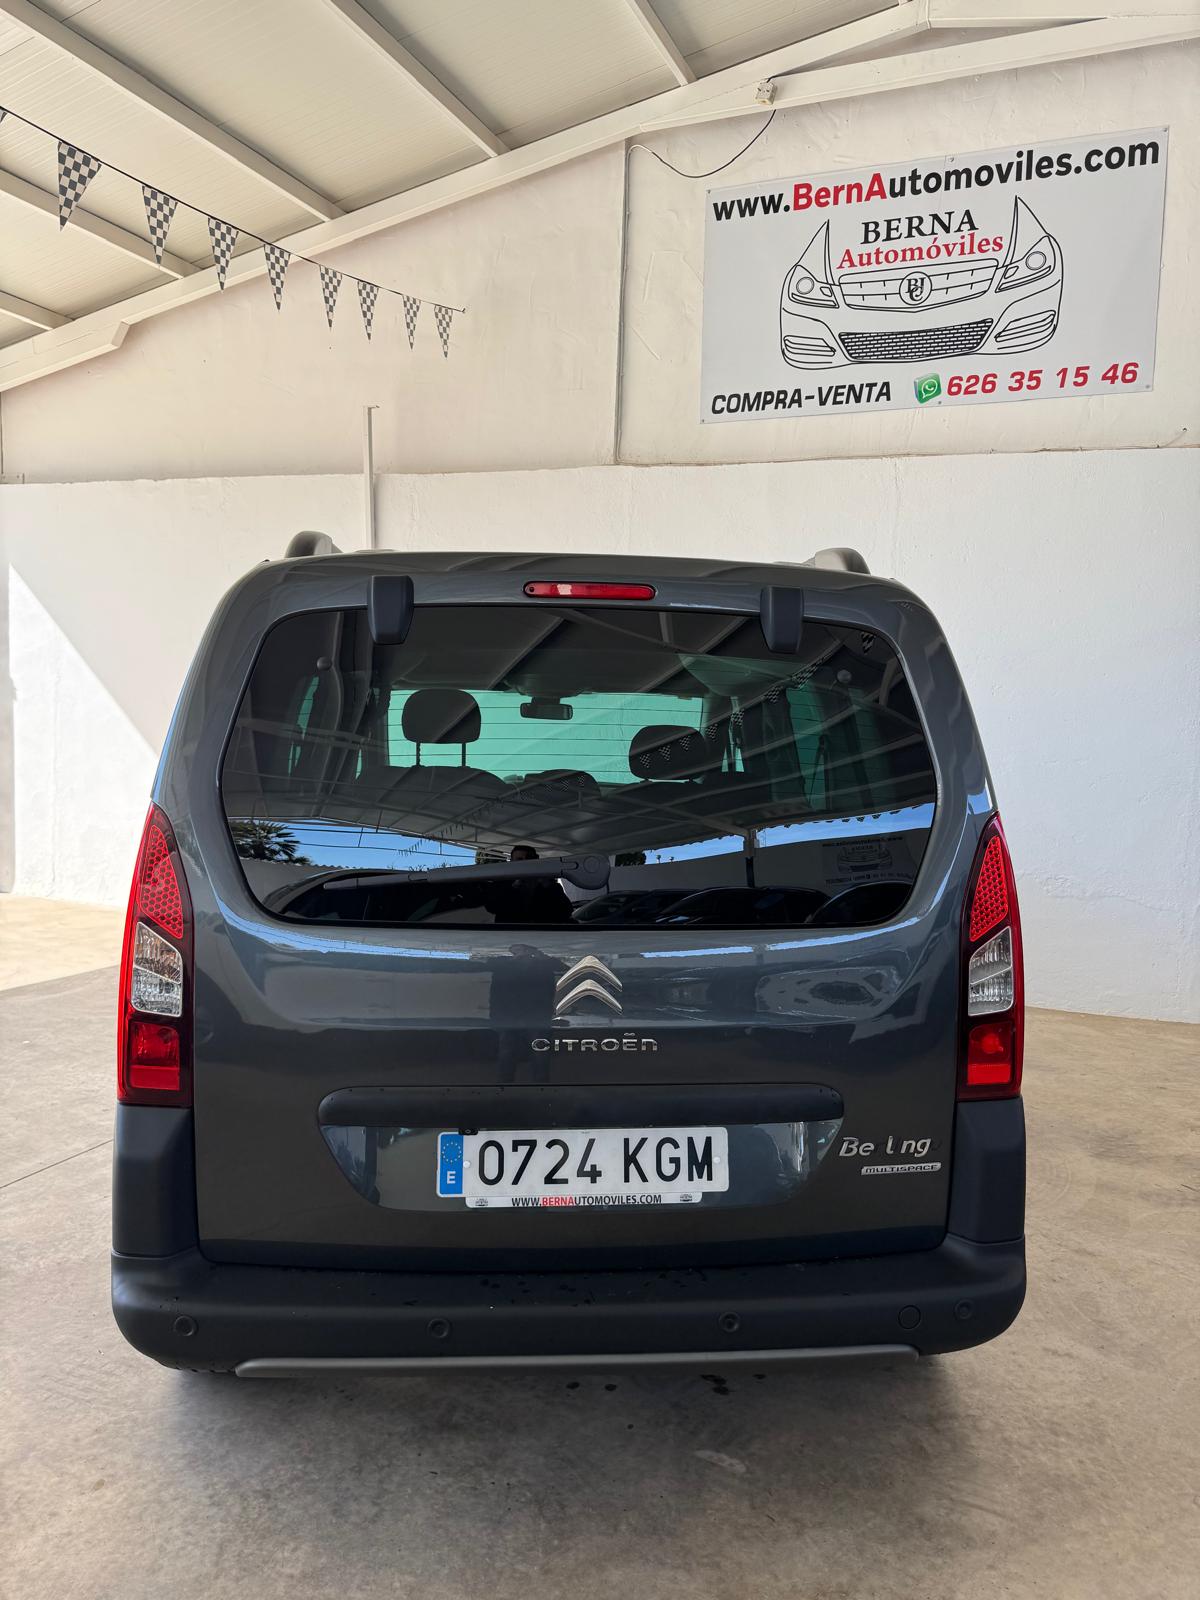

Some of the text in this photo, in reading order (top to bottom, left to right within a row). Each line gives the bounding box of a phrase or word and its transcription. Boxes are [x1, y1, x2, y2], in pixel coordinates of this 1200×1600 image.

[713, 141, 1160, 221] www.BernAutomoviles.com
[860, 209, 979, 245] BERNA
[838, 232, 1004, 269] Automóviles
[947, 361, 1139, 397] 626 35 15 46
[711, 381, 892, 415] COMPRA-VENTA
[446, 1136, 713, 1186] E 0724 KGM
[864, 1164, 938, 1174] MULTISPACE
[511, 1194, 662, 1207] WWW.BERNAUTOMOVILES.COM
